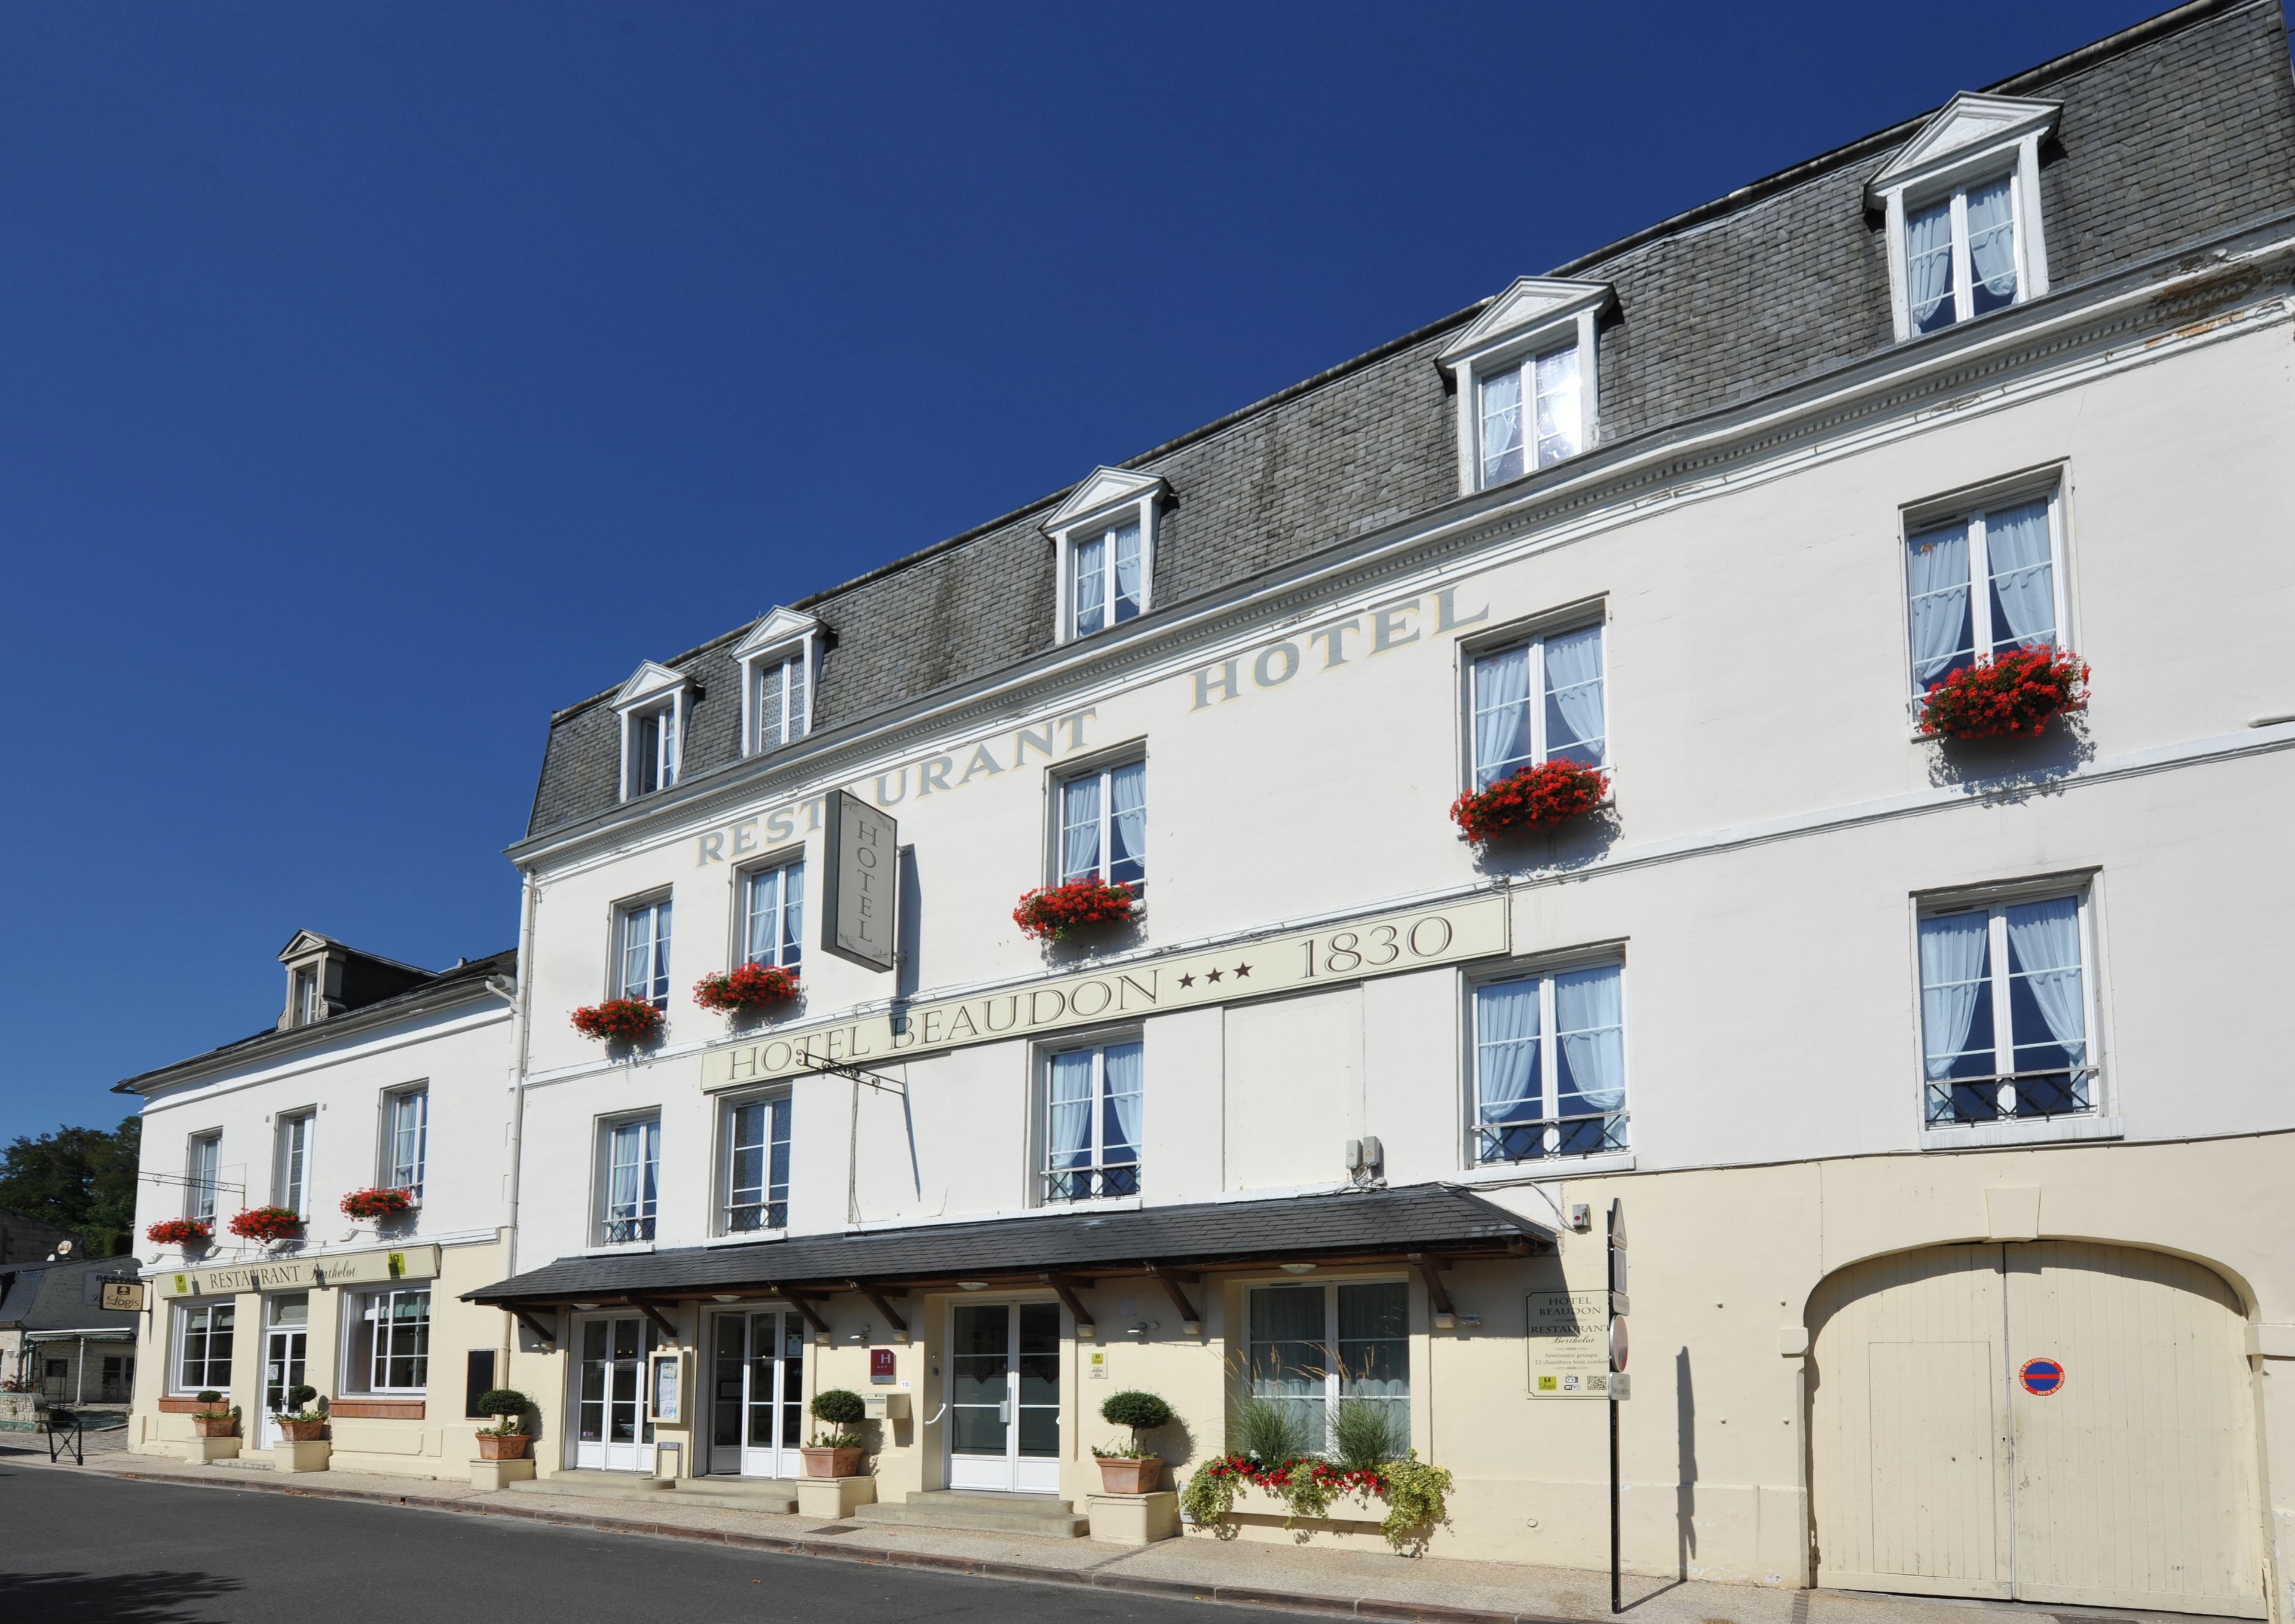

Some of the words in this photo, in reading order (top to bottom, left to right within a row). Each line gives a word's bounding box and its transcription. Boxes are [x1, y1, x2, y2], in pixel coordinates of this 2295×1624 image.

[695, 707, 1097, 869] RESTURANT
[1187, 585, 1489, 715] HOTEL
[856, 819, 879, 943] HOTEL
[727, 1025, 870, 1080] HOTEL
[890, 969, 1161, 1050] BEAUDON
[1298, 916, 1453, 980] 1830
[210, 1264, 300, 1289] RESTAURANT
[304, 1259, 357, 1282] Berthelot
[106, 1295, 139, 1308] Logis
[1549, 1297, 1592, 1305] HOTEL
[1540, 1307, 1601, 1316] BEAUDON
[1546, 1335, 1596, 1344] Berthelot
[881, 1354, 891, 1363] H
